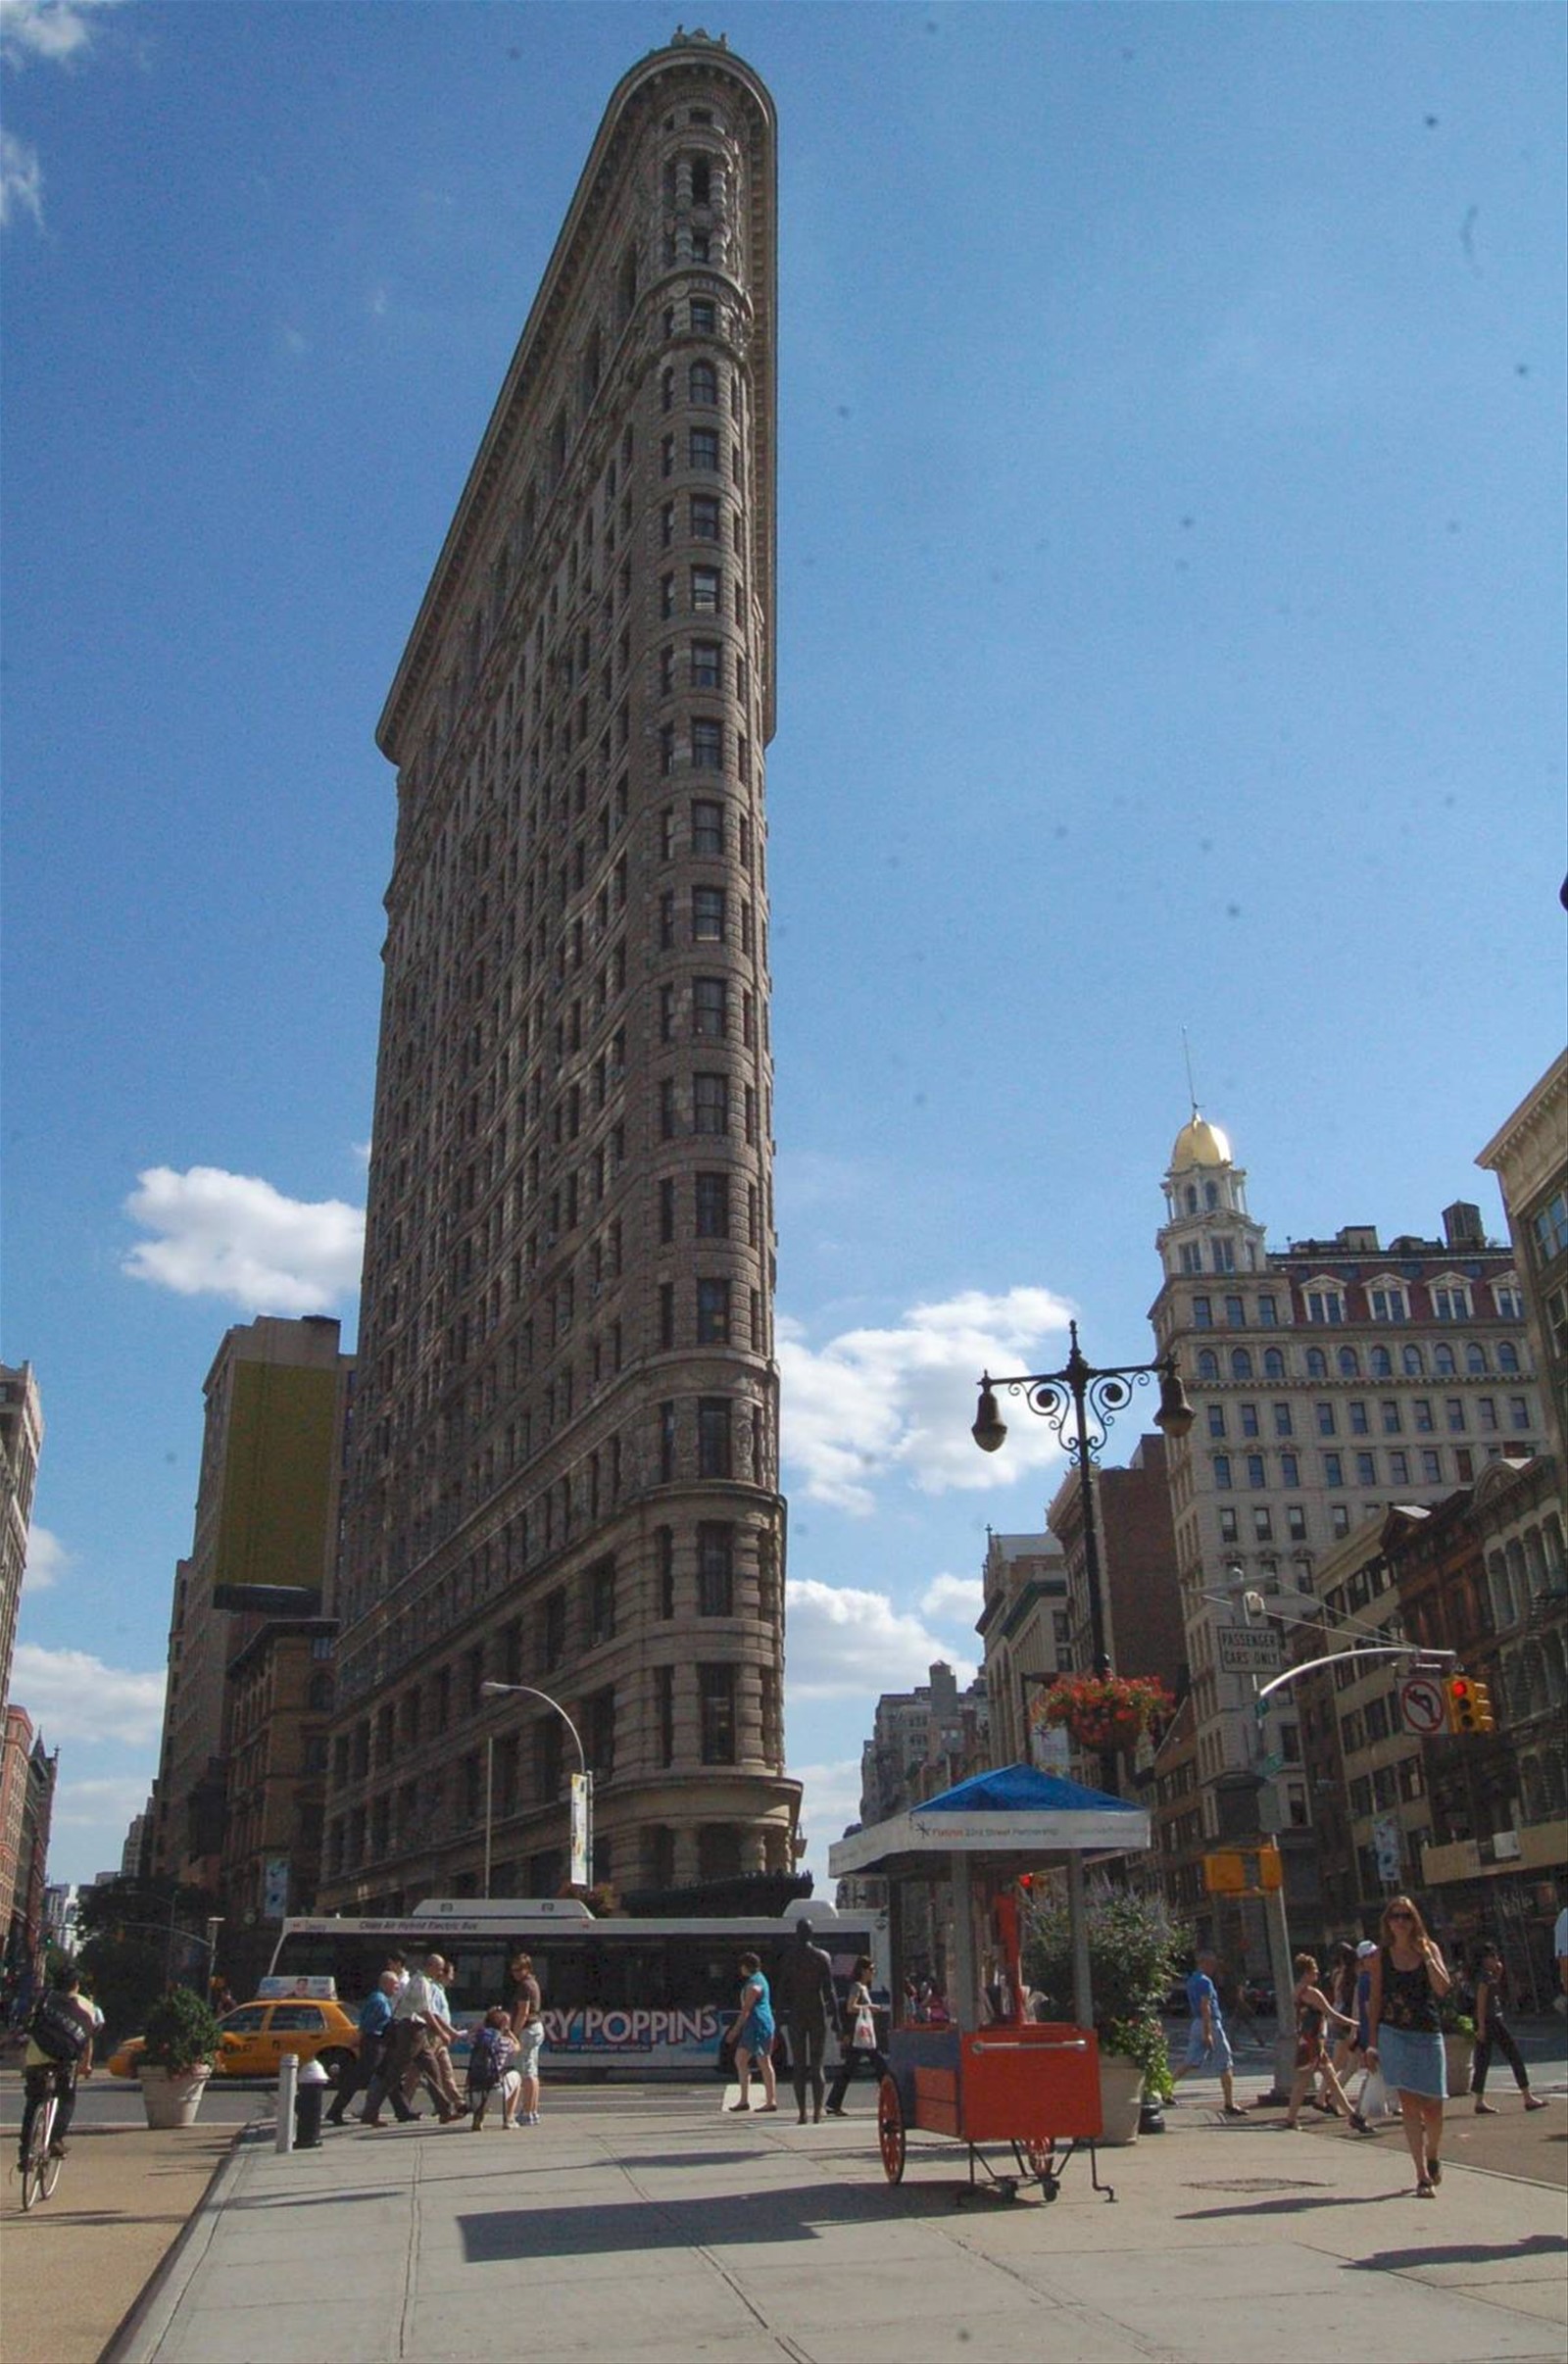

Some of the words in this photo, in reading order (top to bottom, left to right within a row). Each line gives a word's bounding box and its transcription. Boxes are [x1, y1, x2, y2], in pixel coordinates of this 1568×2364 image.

[1221, 1633, 1276, 1648] PASSENGER
[1224, 1650, 1250, 1664] CARS
[1254, 1650, 1278, 1664] ONLY
[462, 1921, 478, 1930] Bus
[585, 2005, 718, 2043] POPPINS
